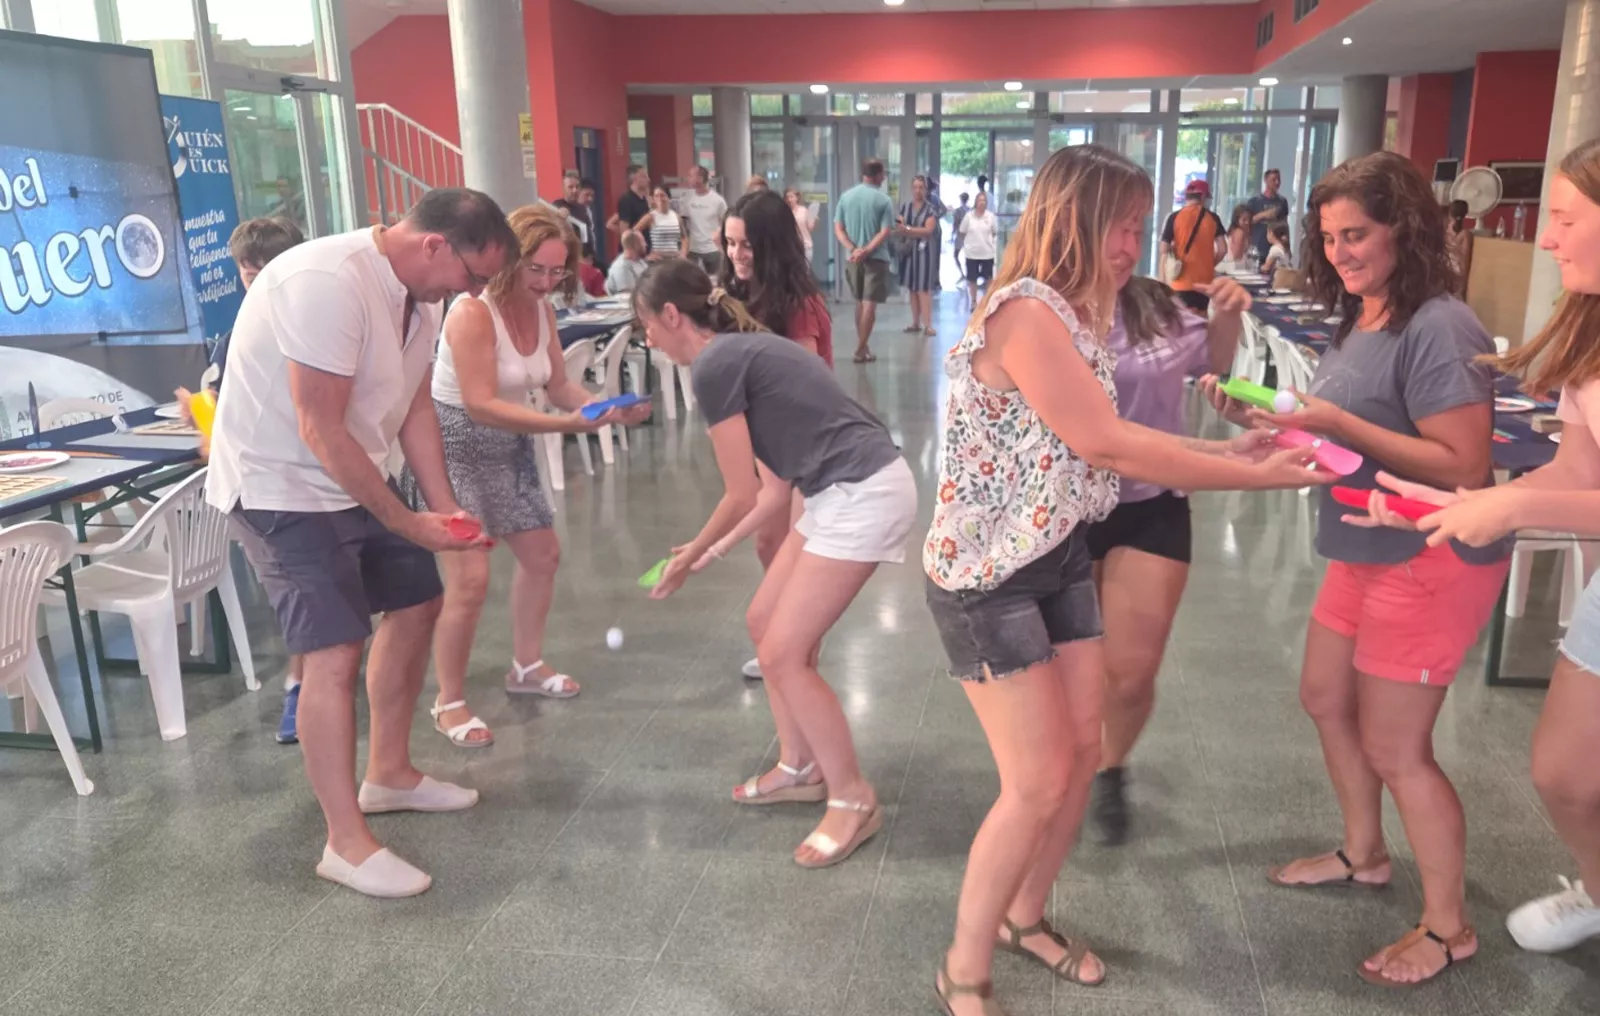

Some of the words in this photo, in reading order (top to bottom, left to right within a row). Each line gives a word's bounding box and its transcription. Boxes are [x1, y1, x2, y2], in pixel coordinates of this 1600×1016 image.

[188, 147, 203, 158] ES
[184, 209, 226, 231] muestra
[188, 234, 206, 253] que
[206, 229, 218, 245] tu
[200, 270, 213, 284] no
[213, 265, 224, 280] es
[107, 390, 124, 404] DE
